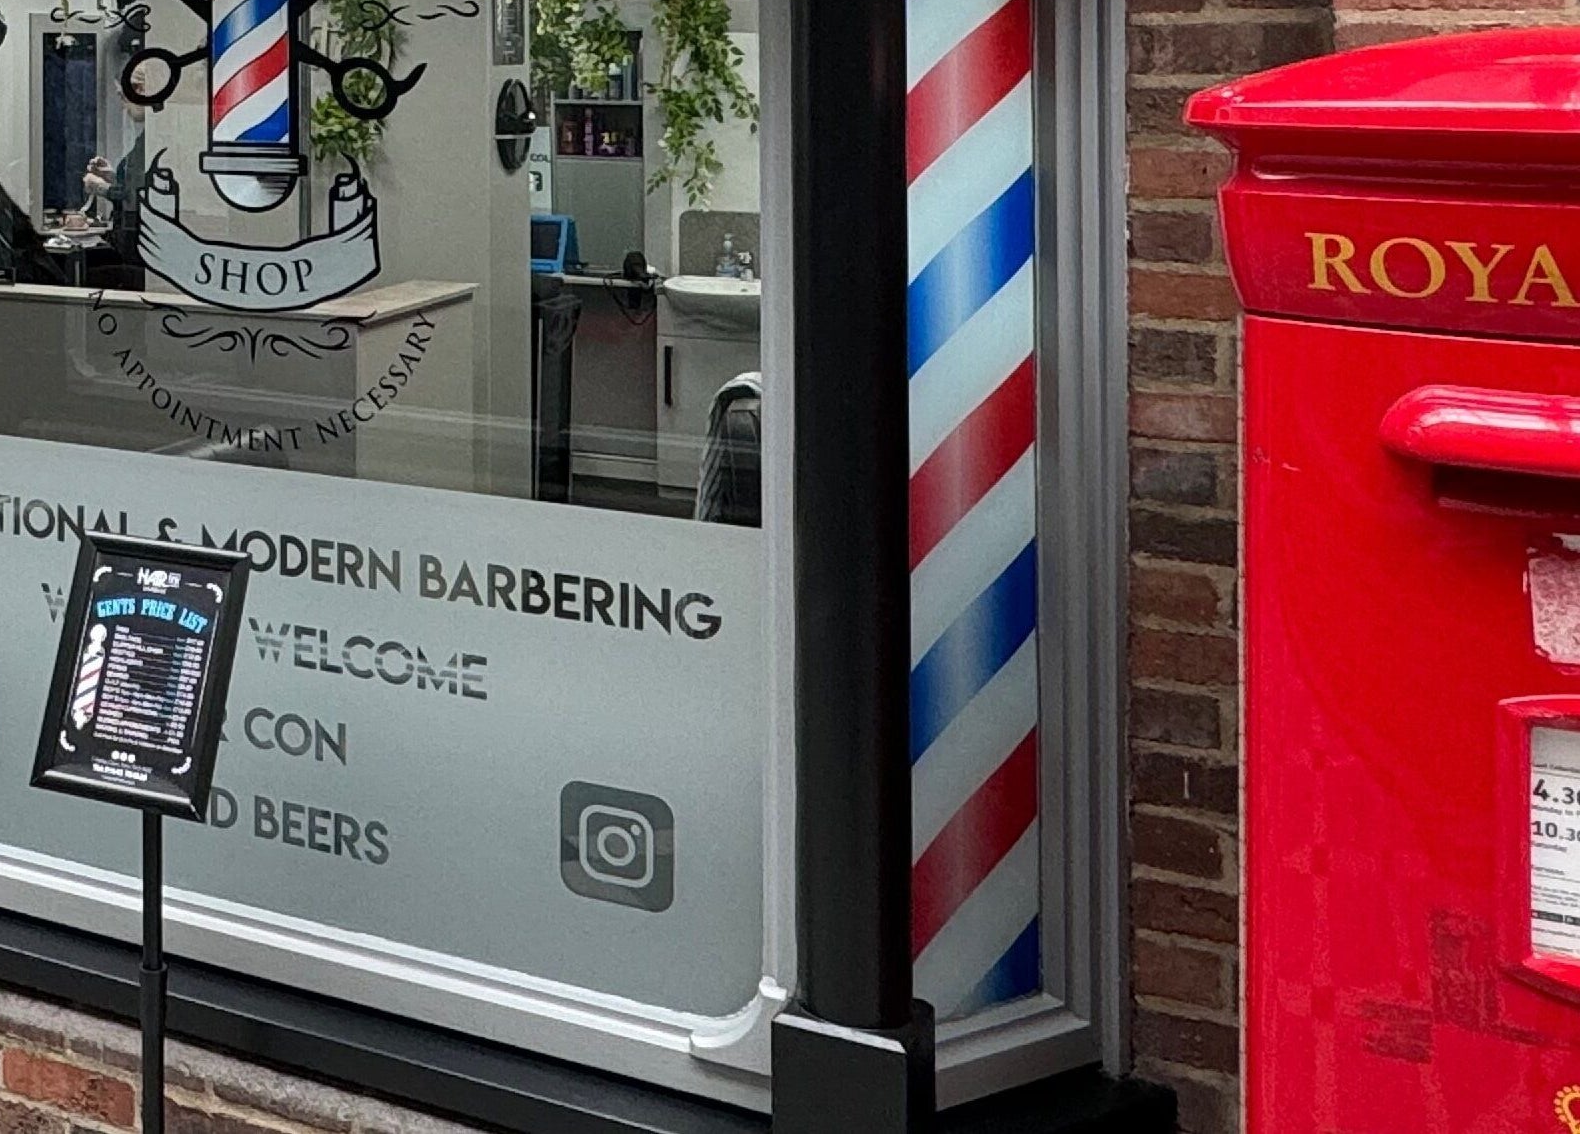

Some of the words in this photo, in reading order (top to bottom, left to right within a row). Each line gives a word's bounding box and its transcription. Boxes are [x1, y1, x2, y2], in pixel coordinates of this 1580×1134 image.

[195, 252, 313, 296] SHOP
[1304, 232, 1580, 307] ROYA
[88, 289, 117, 335] NO
[113, 348, 301, 451] APPOINTMENT
[315, 311, 436, 445] NECESSARY
[96, 598, 136, 618] GENTS
[140, 598, 177, 621] PRICE
[178, 608, 208, 634] LIST
[201, 523, 400, 593] MODERN
[420, 554, 722, 640] BARBERING
[249, 617, 488, 701] WELCOME
[244, 707, 347, 766] CON
[254, 795, 389, 865] BEERS
